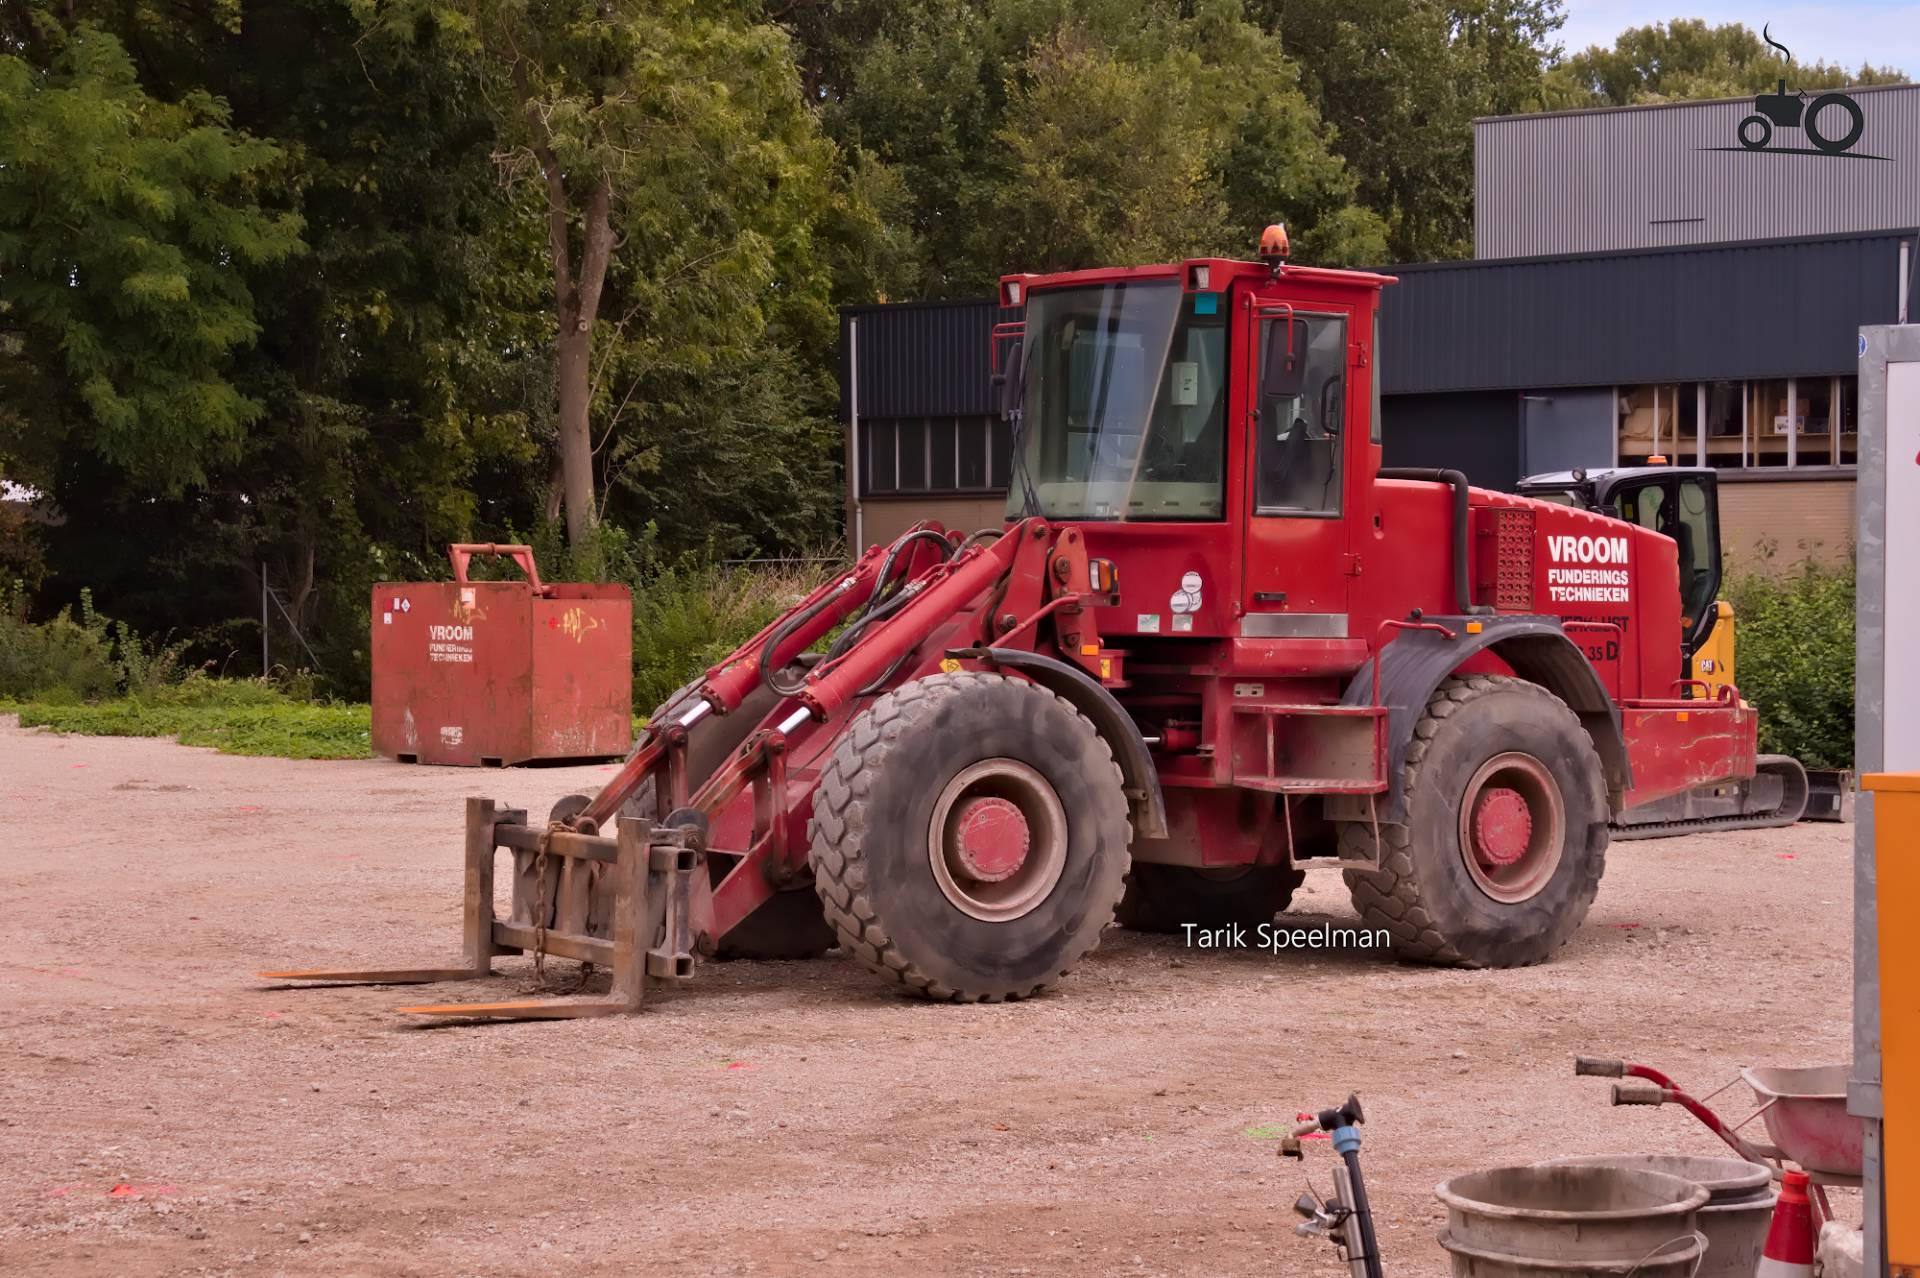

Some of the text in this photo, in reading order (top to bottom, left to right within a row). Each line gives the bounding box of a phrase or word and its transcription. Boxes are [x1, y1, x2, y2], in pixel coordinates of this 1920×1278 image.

[1547, 536, 1628, 563] VROOM
[1548, 569, 1629, 585] FUNDERINGS
[1549, 586, 1629, 602] TECHNIEKEN
[429, 625, 473, 641] VROOM
[1700, 659, 1714, 673] CAT
